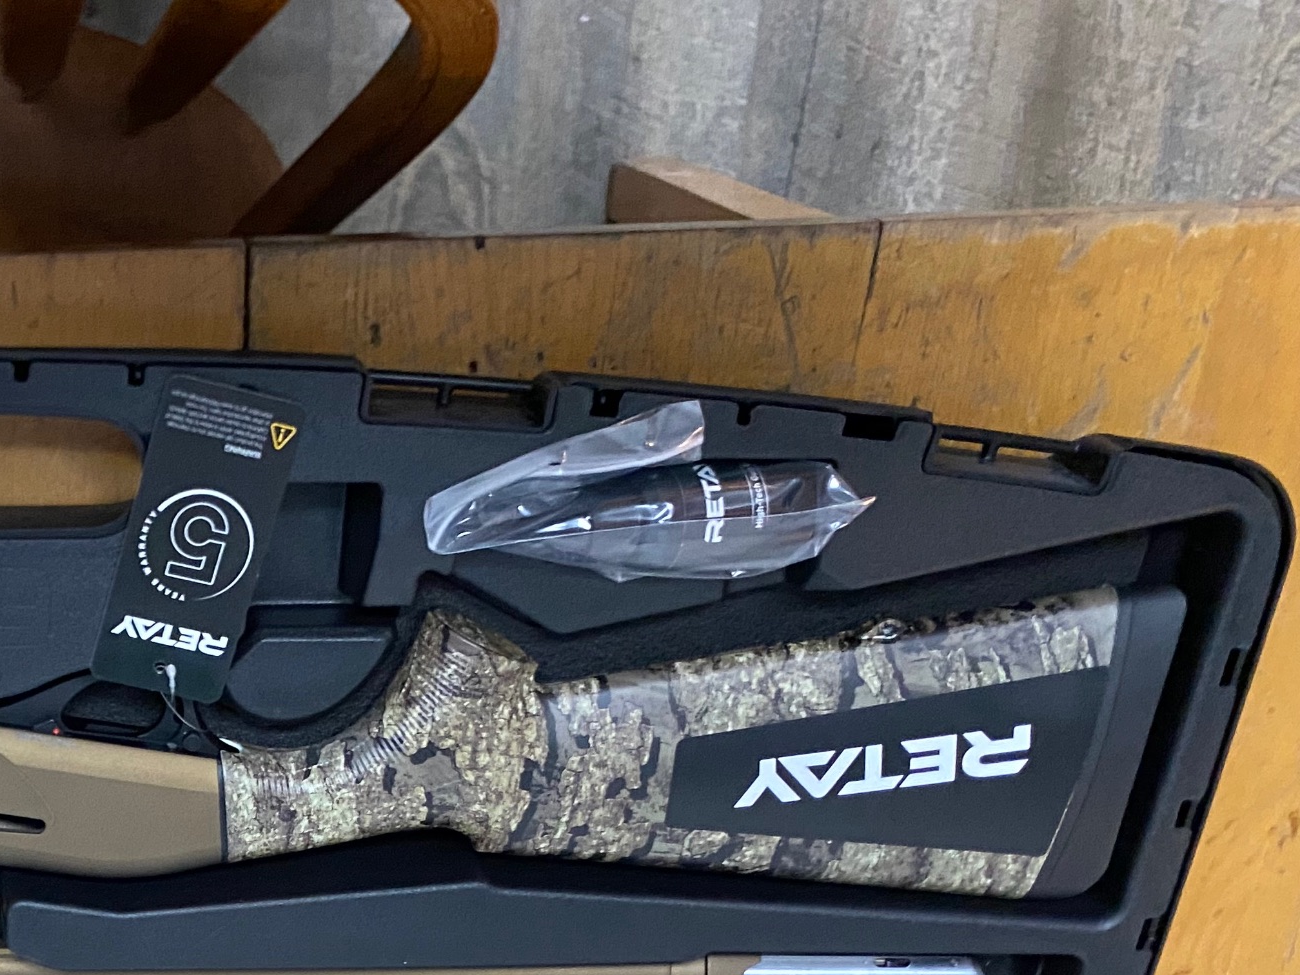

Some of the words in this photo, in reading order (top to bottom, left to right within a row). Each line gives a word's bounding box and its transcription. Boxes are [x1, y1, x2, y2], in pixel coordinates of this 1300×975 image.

[164, 502, 229, 586] 5
[692, 463, 725, 543] RETA
[110, 615, 229, 657] RETAY
[733, 724, 1032, 808] RETAY
